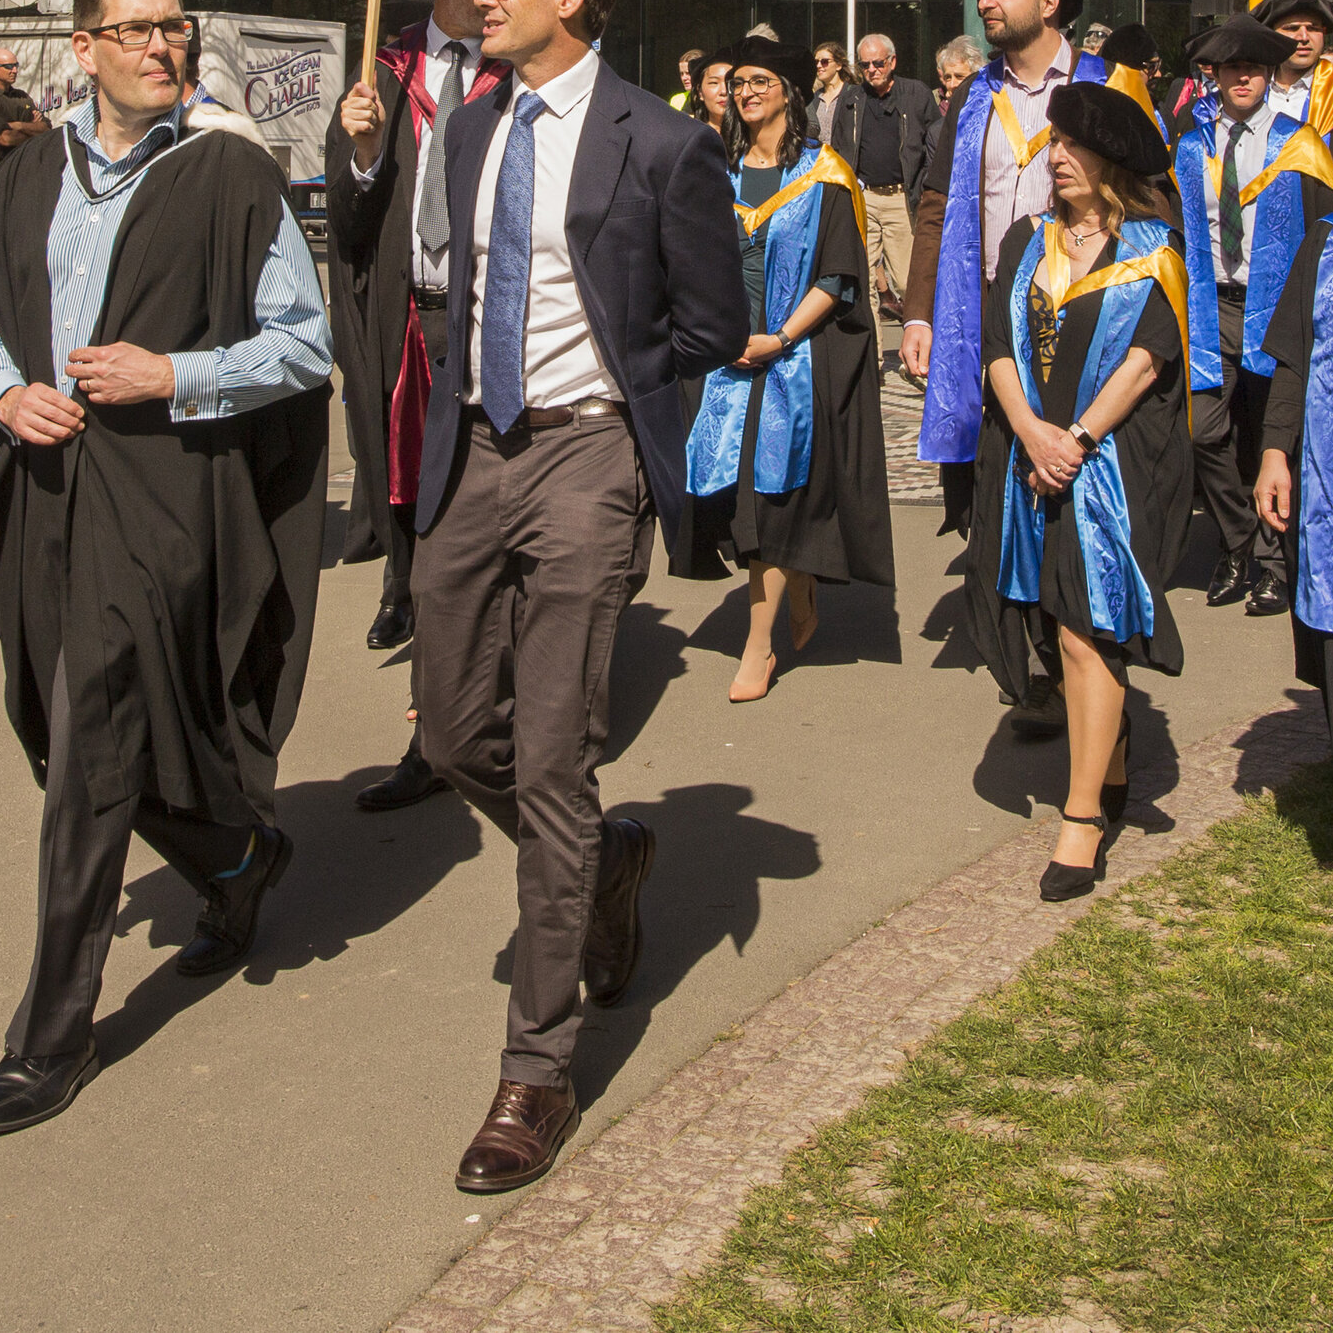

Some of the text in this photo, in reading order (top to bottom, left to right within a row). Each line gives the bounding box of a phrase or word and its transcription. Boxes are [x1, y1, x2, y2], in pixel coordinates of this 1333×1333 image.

[275, 55, 321, 86] ICE CREAM
[67, 78, 87, 104] Ice
[245, 72, 321, 119] CHARLIE
